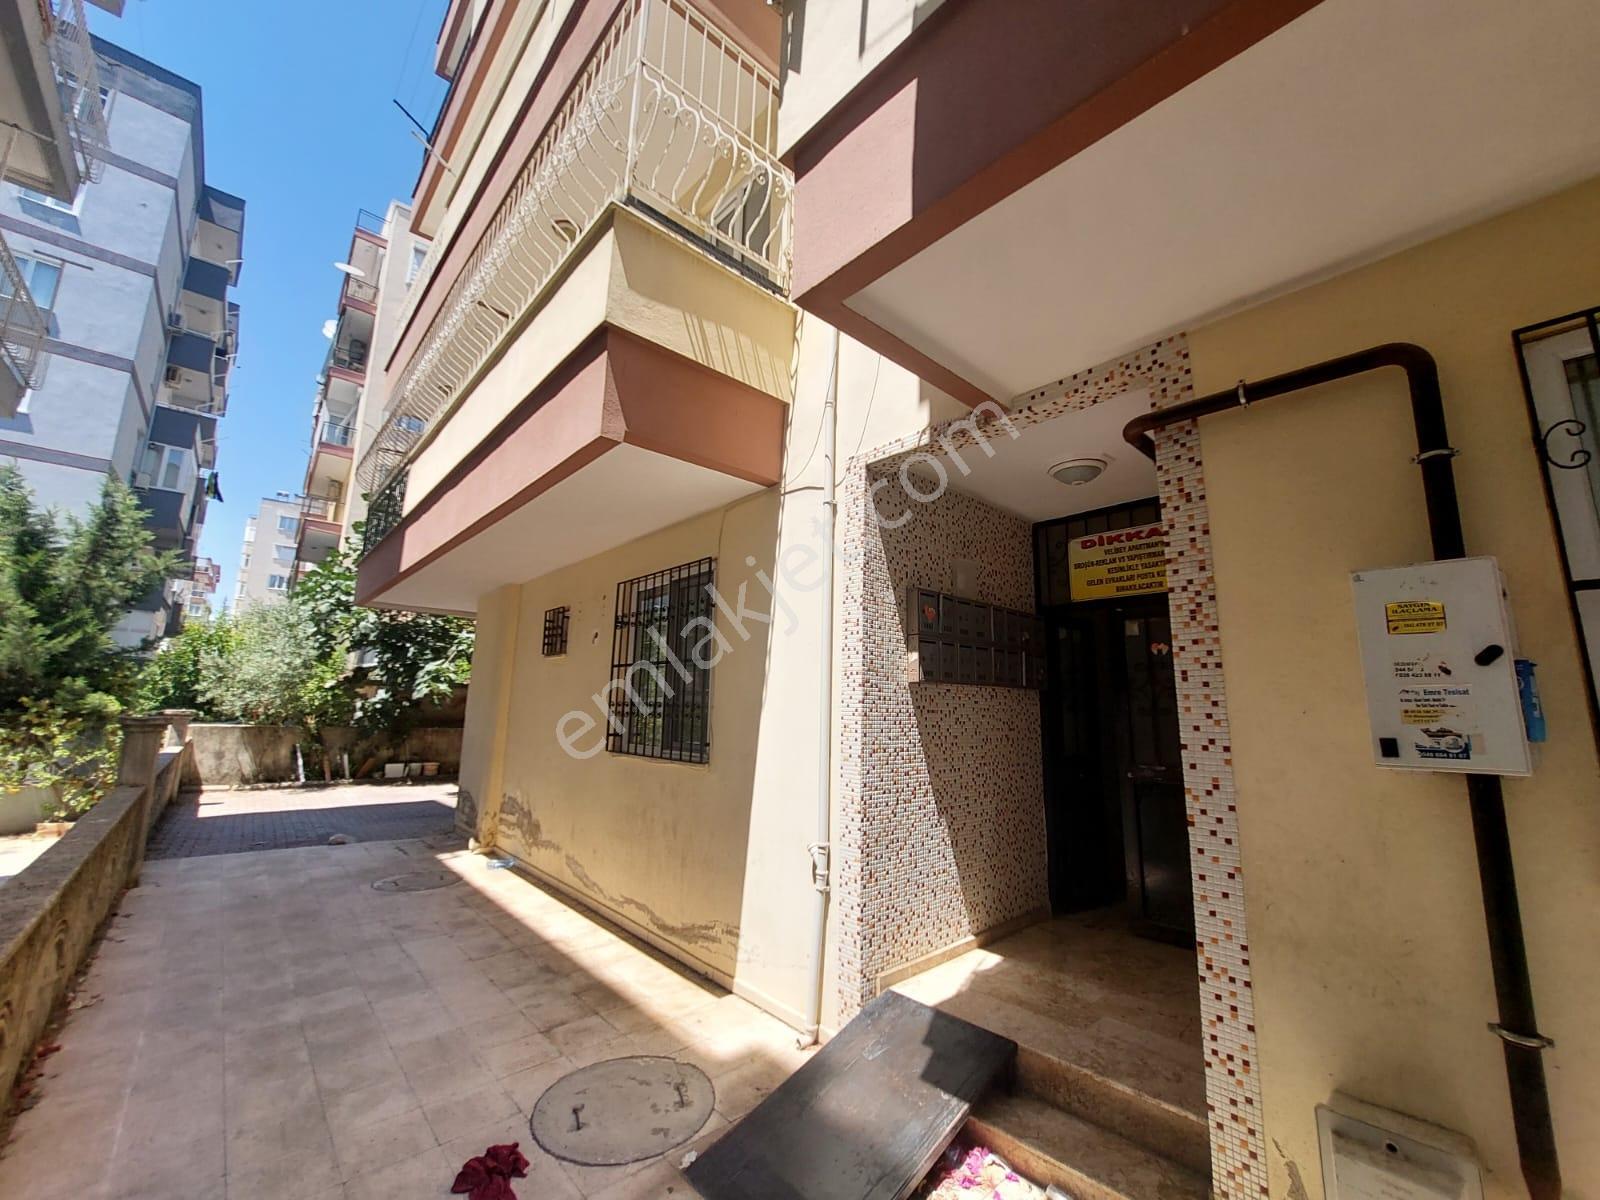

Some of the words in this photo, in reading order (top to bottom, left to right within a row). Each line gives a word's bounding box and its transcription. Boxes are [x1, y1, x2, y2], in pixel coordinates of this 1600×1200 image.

[1081, 527, 1163, 549] DİKKA
[1086, 578, 1104, 587] GELEN
[1136, 572, 1155, 581] POSTA
